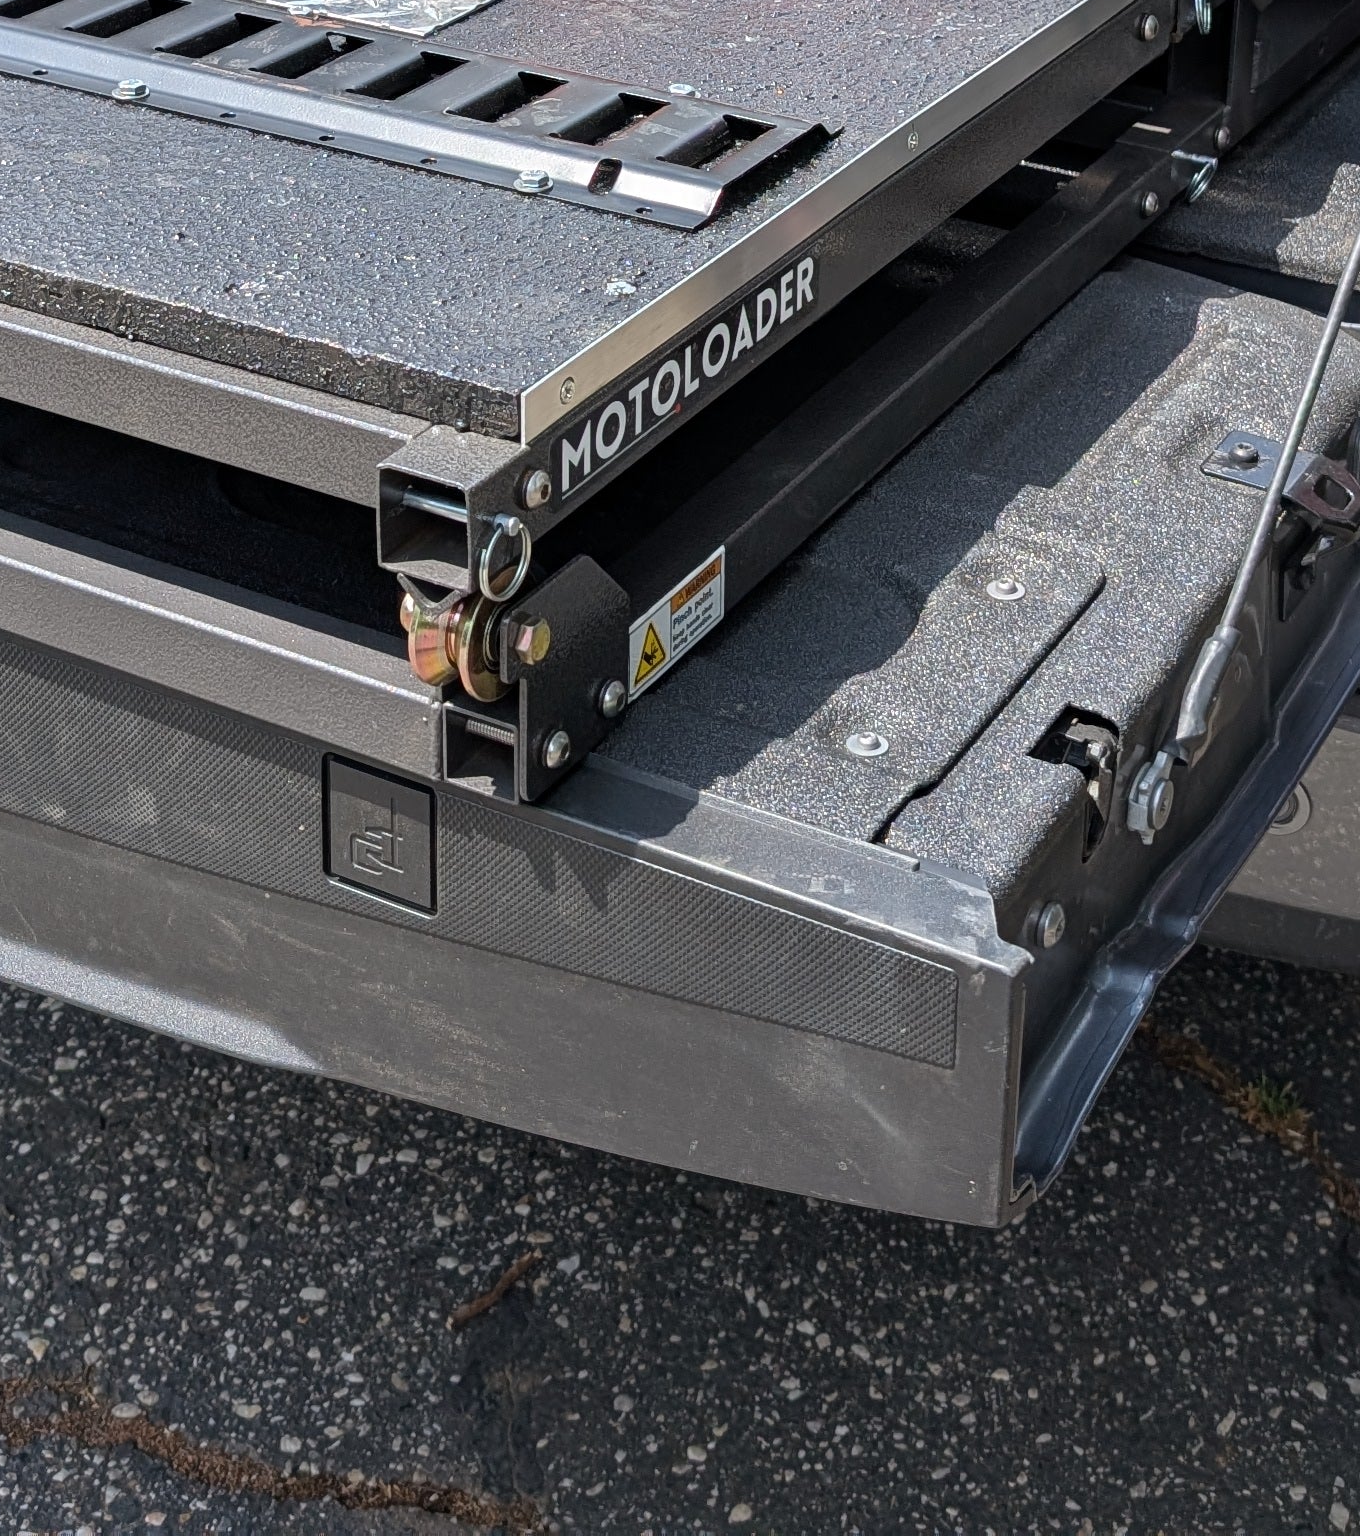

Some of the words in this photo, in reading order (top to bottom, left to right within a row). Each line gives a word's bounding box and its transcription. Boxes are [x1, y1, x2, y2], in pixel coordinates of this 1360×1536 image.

[562, 257, 814, 492] MOTOLOADER
[684, 565, 716, 598] WARNING
[673, 606, 692, 629] Pinch
